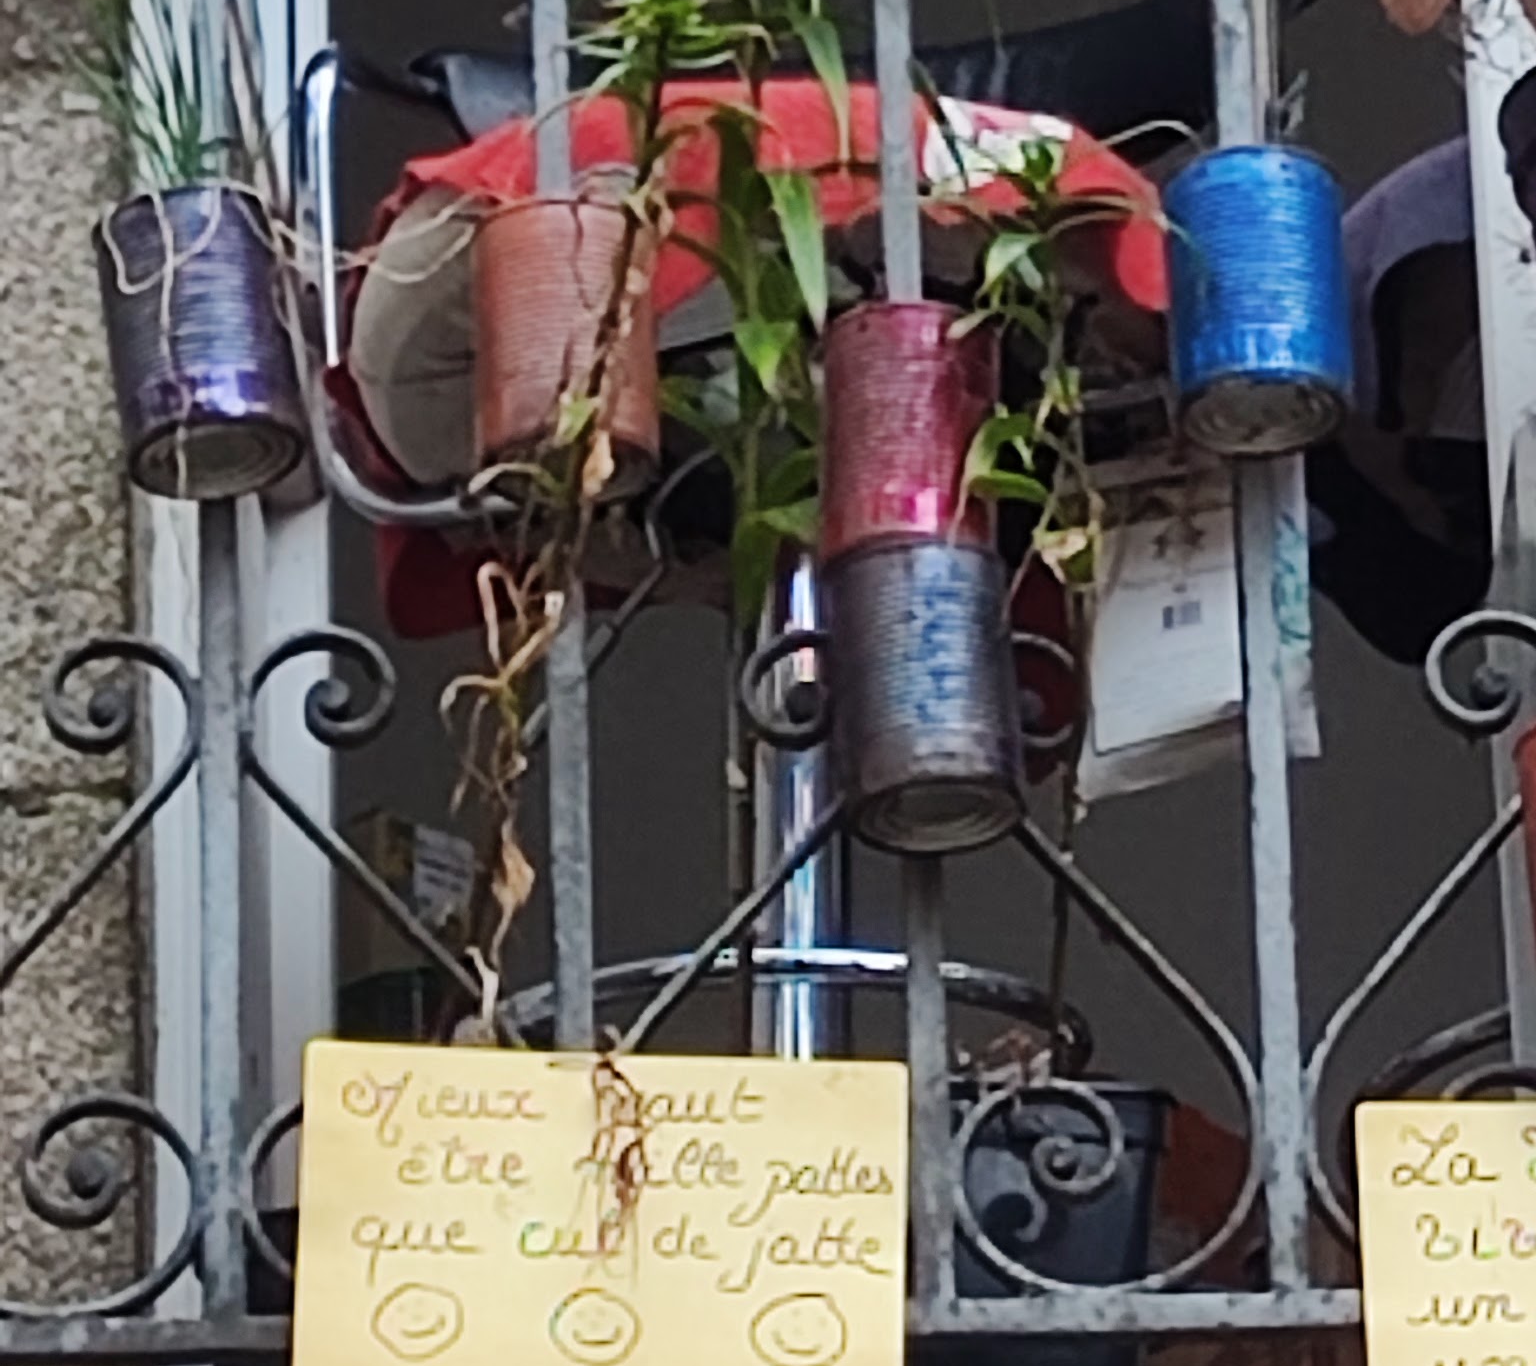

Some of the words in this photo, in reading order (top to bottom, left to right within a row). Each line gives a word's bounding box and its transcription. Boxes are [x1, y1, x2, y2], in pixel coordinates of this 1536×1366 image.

[342, 1072, 547, 1147] Mieux
[398, 1138, 530, 1187] être
[728, 1147, 894, 1227] pattes
[1392, 1124, 1498, 1186] La
[351, 1214, 484, 1288] que
[653, 1213, 721, 1261] de
[717, 1217, 896, 1293] jatte
[1407, 1299, 1526, 1327] un
